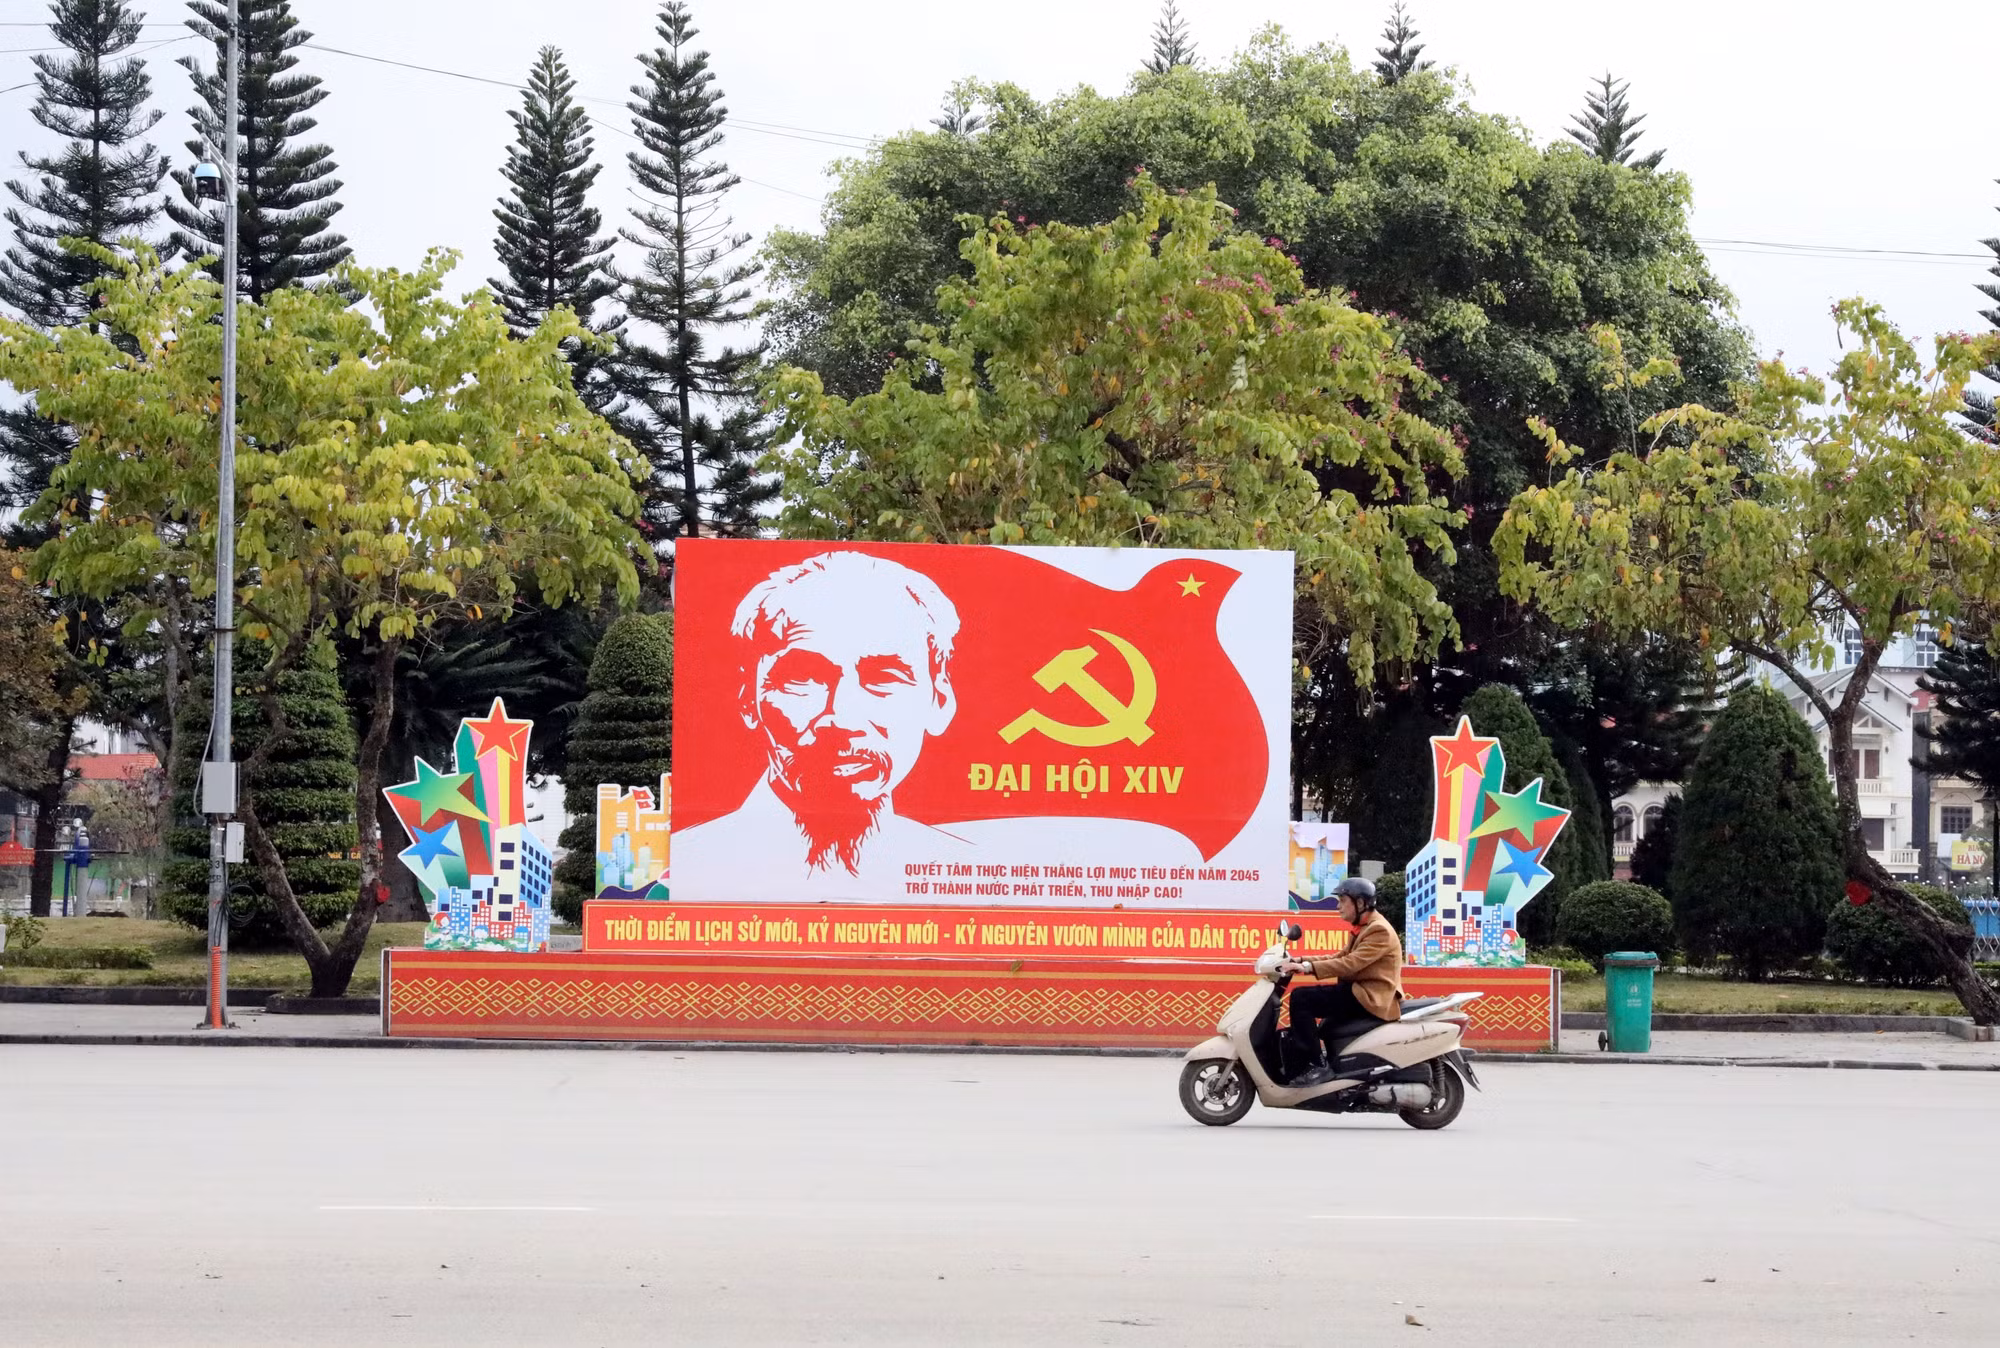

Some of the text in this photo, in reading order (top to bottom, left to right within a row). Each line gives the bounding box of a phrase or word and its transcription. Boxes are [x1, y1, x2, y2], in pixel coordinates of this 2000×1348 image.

[968, 758, 1184, 799] ĐẠI HỘI XIV
[905, 860, 943, 876] QUYẾT
[947, 862, 972, 877] TÂM
[976, 864, 1007, 879] THỰC
[1011, 864, 1039, 880] HIỆN
[1087, 866, 1105, 881] LỢI
[1109, 866, 1137, 881] MỤC
[1141, 865, 1166, 879] TIÊU
[1170, 864, 1195, 880] ĐẾN
[1198, 866, 1227, 881] NĂM
[1230, 869, 1260, 881] 2045
[906, 878, 1183, 900] TRỞ THÀNH NƯỚC PHÁT TRIỂN, THU NHẬP CAO!
[605, 915, 643, 941] THỜI
[647, 912, 690, 941] ĐIỂM
[696, 920, 733, 946] LỊCH
[737, 914, 763, 942] SỬ
[765, 918, 802, 945] MỚI,
[808, 915, 830, 943] KỶ
[834, 919, 901, 944] NGUYÊN
[906, 919, 939, 945] MỚI
[955, 917, 977, 945] KỶ
[981, 920, 1049, 946] NGUYÊN
[1053, 923, 1098, 946] VƯƠN
[1103, 922, 1147, 948] MÌNH
[1152, 920, 1185, 948] CỦA
[1190, 923, 1225, 949] DÂN
[1229, 924, 1260, 953] TỘC
[1304, 929, 1348, 951] NAM!
